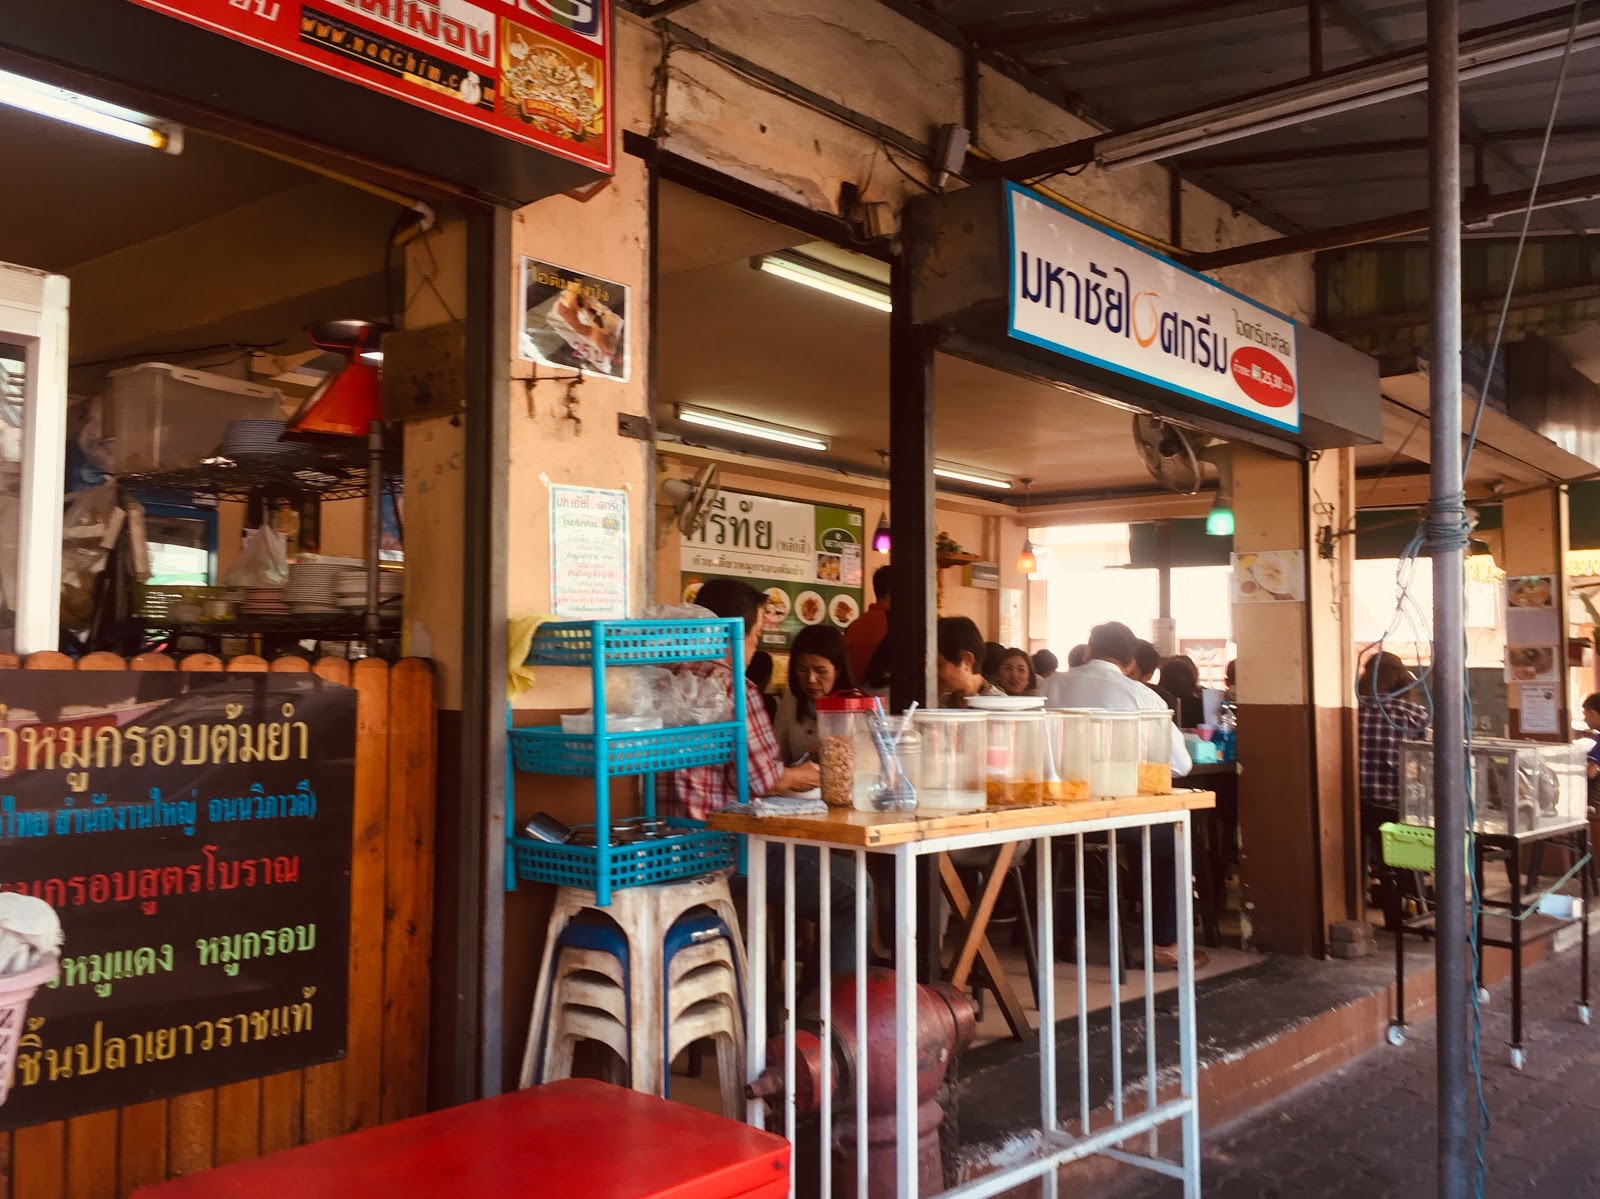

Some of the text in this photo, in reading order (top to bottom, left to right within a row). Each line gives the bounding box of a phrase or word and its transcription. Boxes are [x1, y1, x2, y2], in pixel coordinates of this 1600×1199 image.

[1020, 250, 1228, 375] มหาชัยไอศกรีม
[0, 795, 49, 839] ไทย
[55, 787, 199, 835] สำนักงานใหญ่
[196, 923, 317, 977] หมูกรอบ
[8, 986, 318, 1089] ชิ้นปลาเยาวราชแท้
